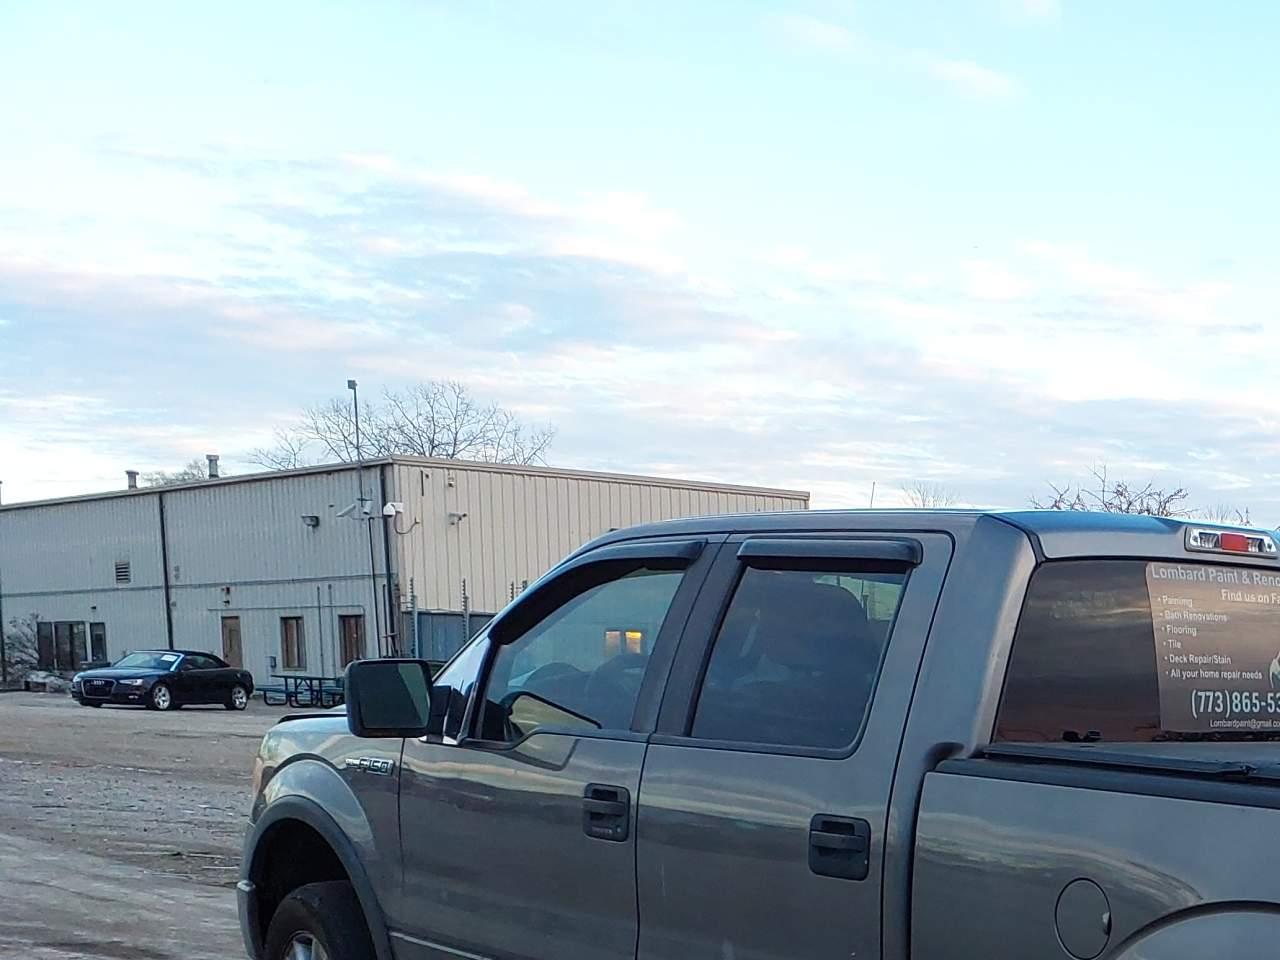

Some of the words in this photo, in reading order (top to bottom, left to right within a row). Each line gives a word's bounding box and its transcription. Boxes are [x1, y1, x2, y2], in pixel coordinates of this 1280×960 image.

[1151, 564, 1206, 582] Lombard
[1208, 567, 1239, 585] Paint
[1241, 571, 1251, 585] &
[1221, 589, 1242, 601] Find
[1244, 593, 1256, 602] us
[1257, 594, 1270, 603] on
[1183, 612, 1228, 622] Renovations
[1166, 624, 1197, 637] Flooring
[1167, 639, 1182, 649] Tile
[1169, 654, 1188, 664] Deck
[1189, 654, 1232, 666] Repair/Stain
[1170, 670, 1181, 679] All
[1182, 671, 1198, 681] your
[1200, 670, 1219, 679] home
[1220, 670, 1241, 681] repair
[1242, 670, 1262, 680] needs
